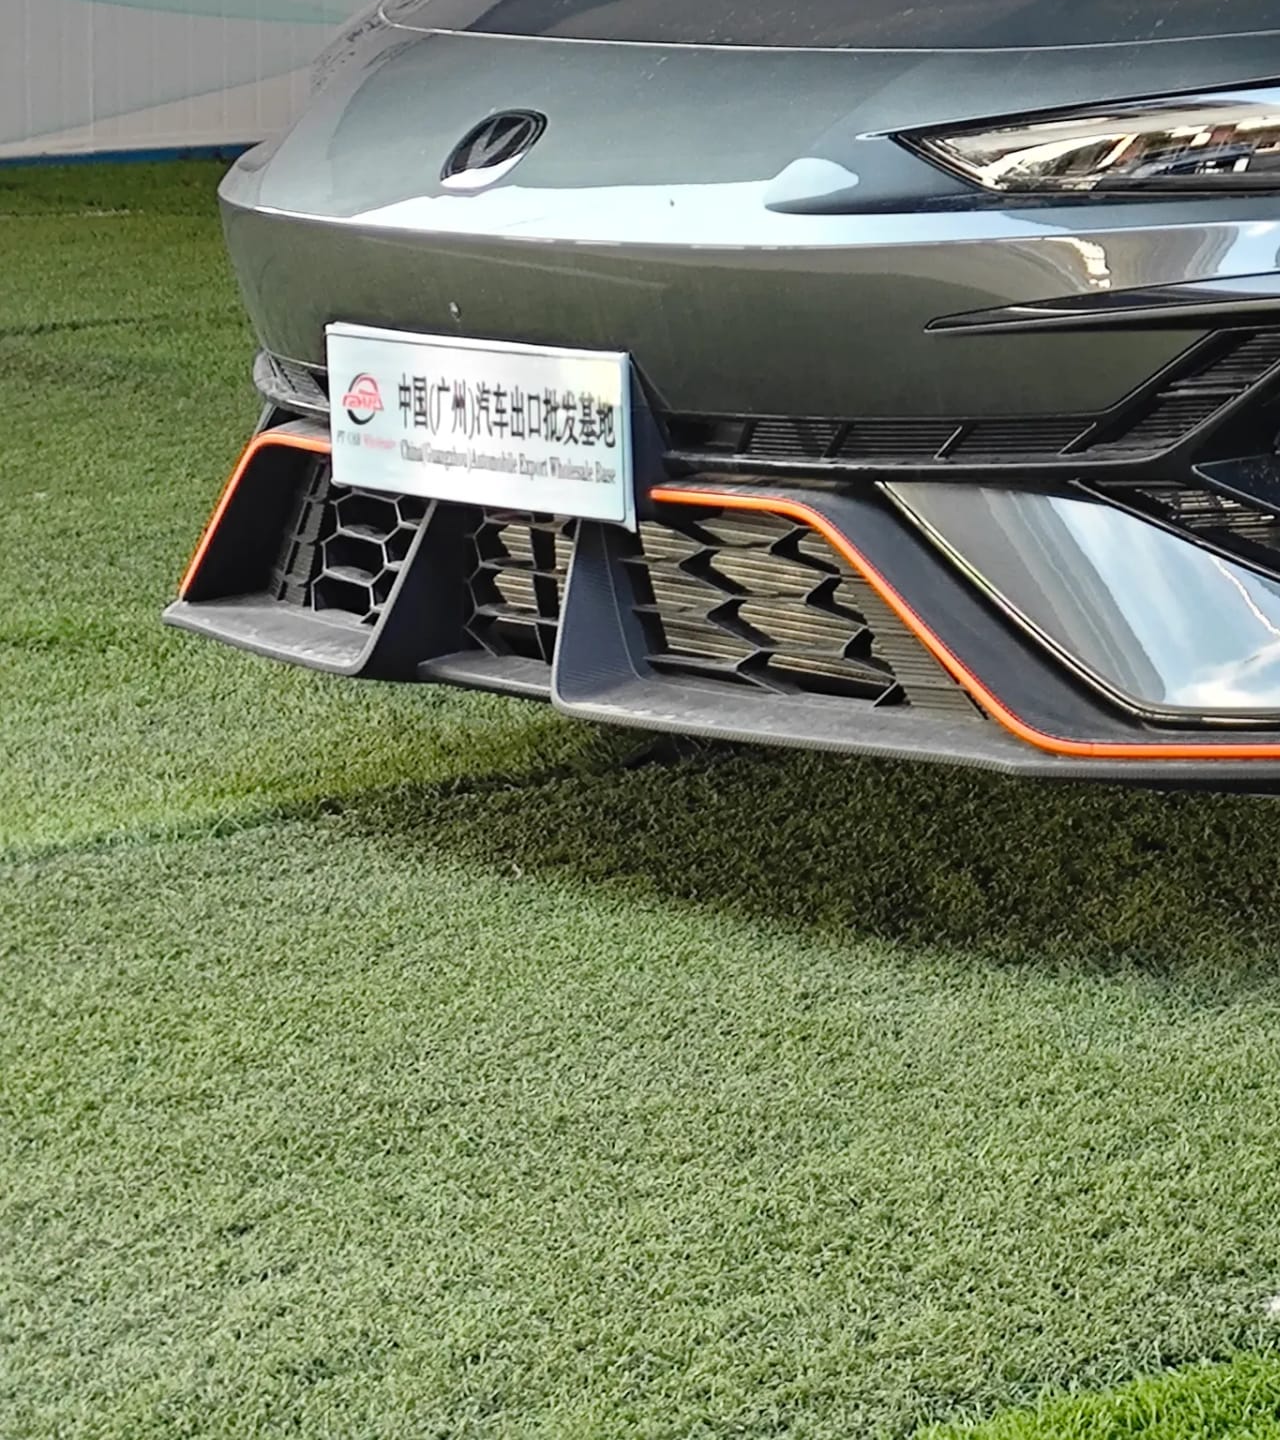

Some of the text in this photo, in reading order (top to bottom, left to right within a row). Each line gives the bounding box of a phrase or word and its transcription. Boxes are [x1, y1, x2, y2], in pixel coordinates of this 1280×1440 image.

[397, 372, 616, 449] 中国(广州)汽车出口批发基地
